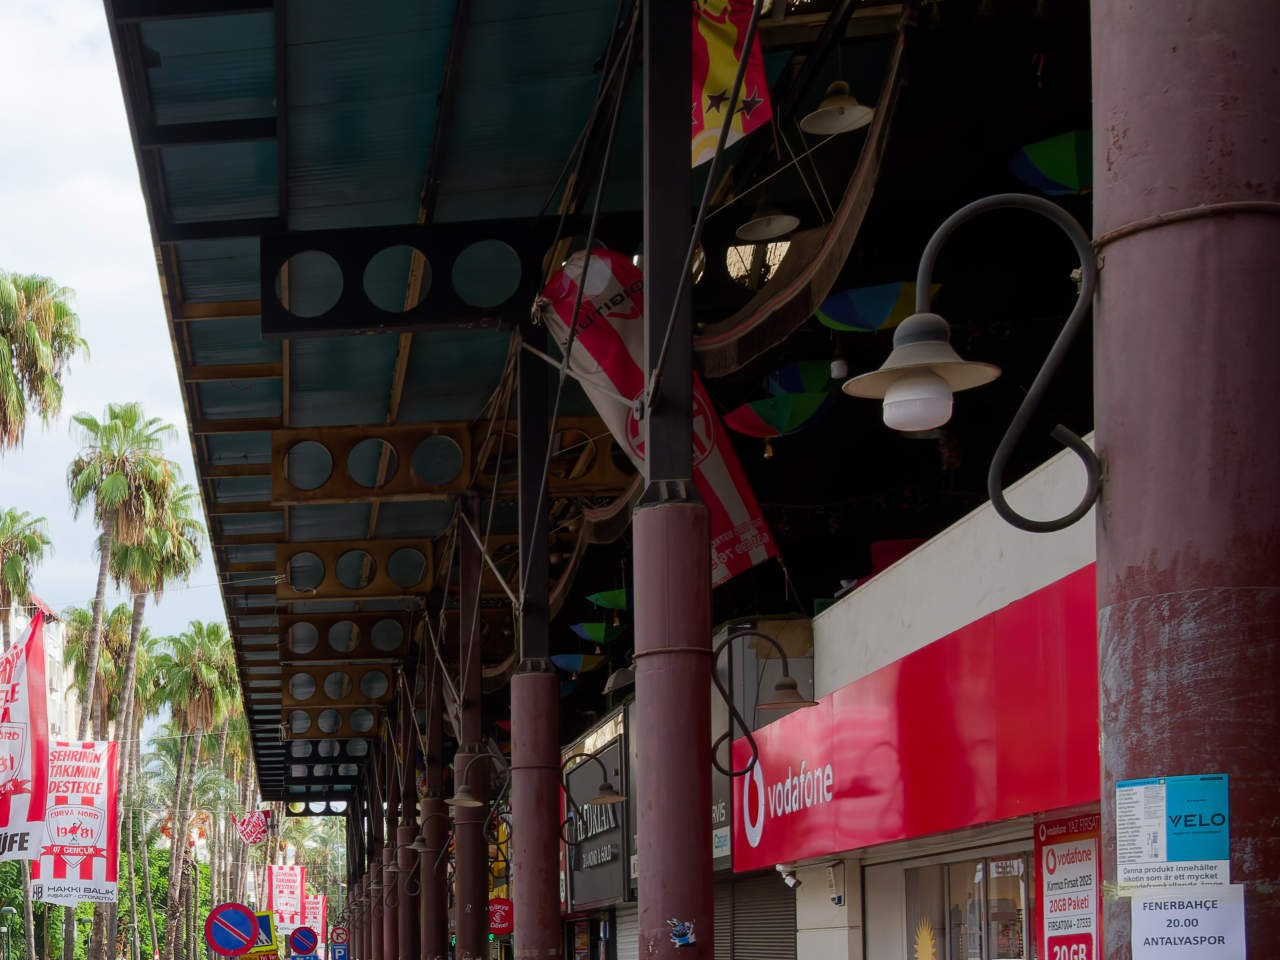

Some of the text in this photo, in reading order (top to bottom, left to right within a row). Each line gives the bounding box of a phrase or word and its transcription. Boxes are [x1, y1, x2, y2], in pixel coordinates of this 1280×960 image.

[48, 780, 103, 795] DESTEKLE
[767, 760, 834, 819] vodafone
[1168, 813, 1226, 828] VELO
[1057, 847, 1092, 867] vodafone
[1144, 865, 1174, 874] produkt
[1173, 873, 1186, 881] ett
[1187, 873, 1218, 882] mycket
[1067, 895, 1090, 912] Paketi
[1143, 899, 1219, 911] FENERBAHÇE
[1166, 918, 1199, 928] 20.00
[1143, 935, 1226, 947] ANTALYASPOR
